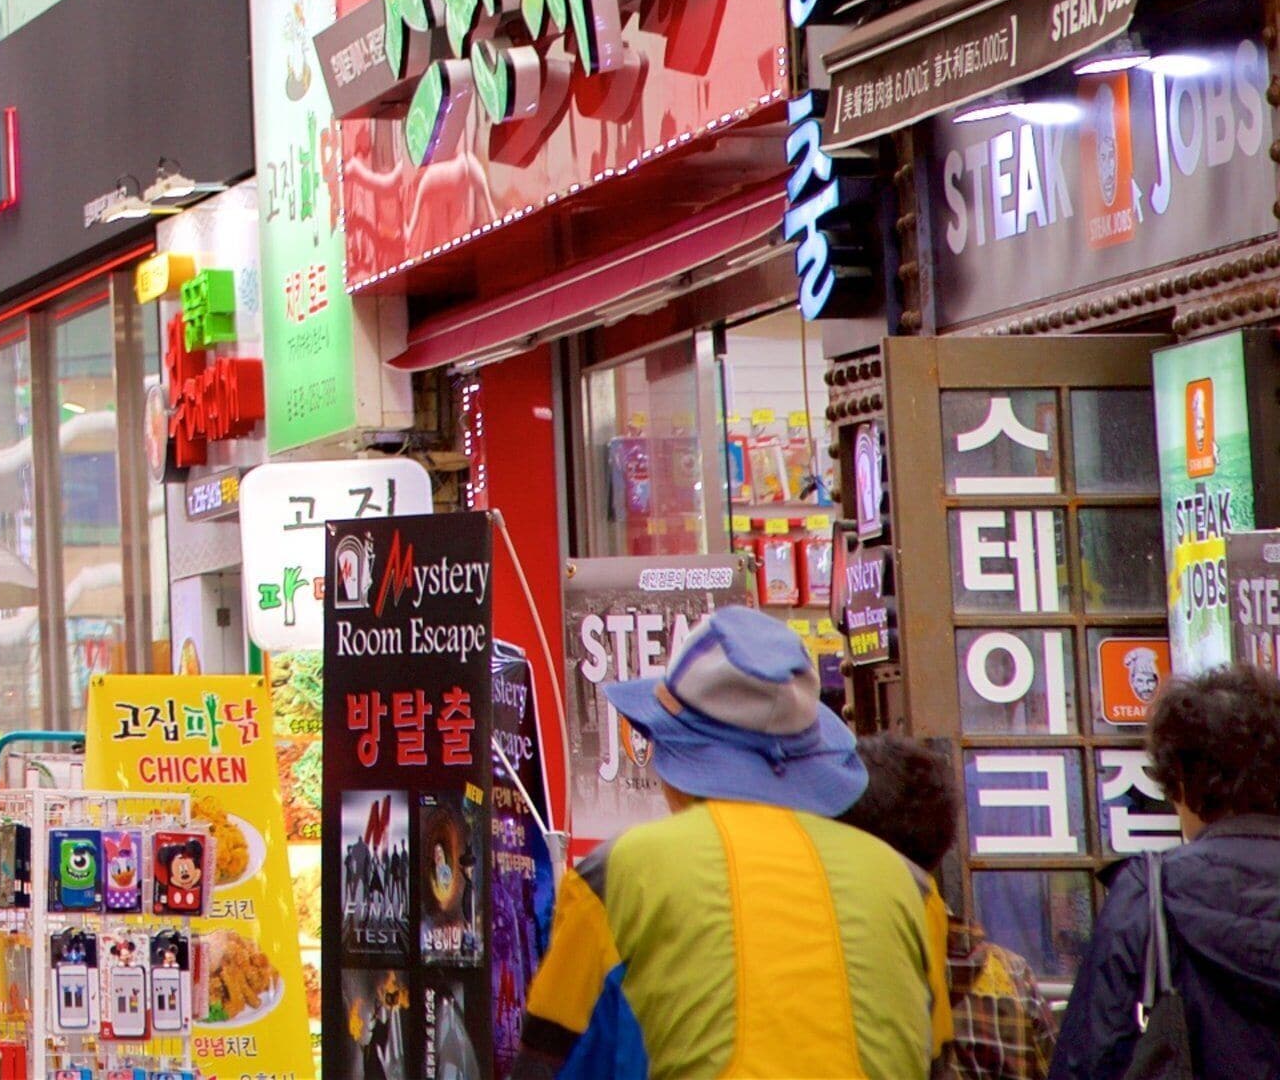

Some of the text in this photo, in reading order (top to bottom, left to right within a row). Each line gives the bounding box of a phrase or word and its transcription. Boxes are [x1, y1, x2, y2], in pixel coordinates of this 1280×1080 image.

[944, 40, 1265, 255] STEAK JOBS
[1175, 487, 1233, 544] STEAK
[374, 528, 490, 618] Mystery
[846, 557, 884, 606] ystery
[1186, 558, 1228, 623] JOBS
[337, 618, 487, 663] Room Escape
[580, 612, 712, 684] STEA
[952, 397, 1078, 854] 스테이크
[113, 693, 259, 753] 고집파닭
[347, 686, 476, 767] 방탈출
[138, 756, 248, 786] CHICKEN
[343, 901, 408, 923] FINAL
[354, 929, 400, 945] TEST
[194, 1036, 258, 1057] 양념치킨
